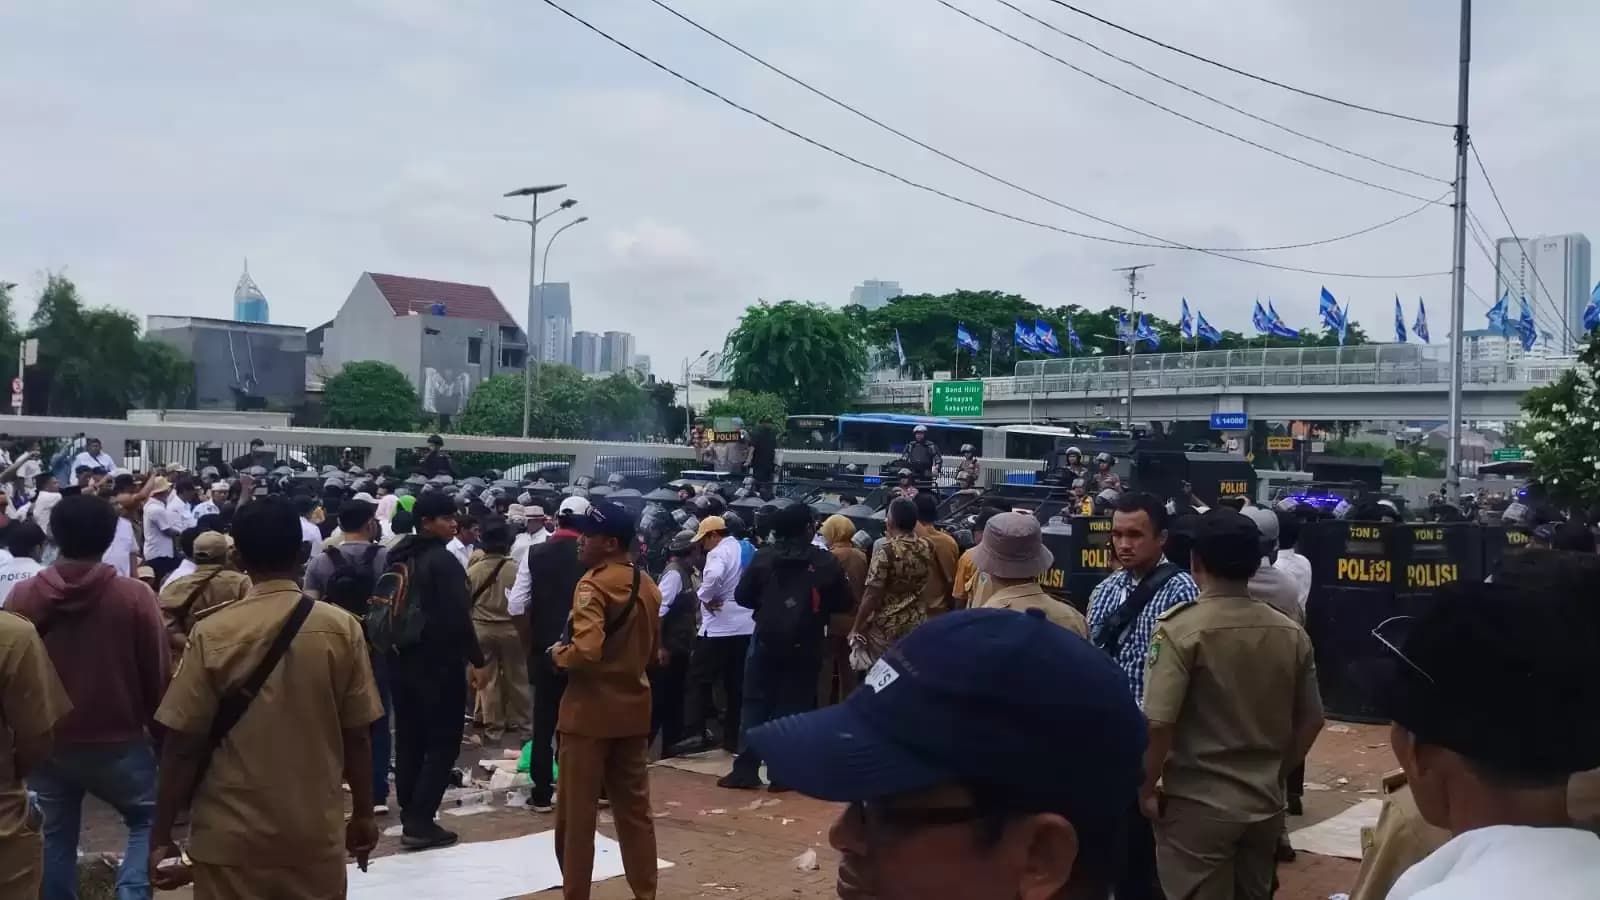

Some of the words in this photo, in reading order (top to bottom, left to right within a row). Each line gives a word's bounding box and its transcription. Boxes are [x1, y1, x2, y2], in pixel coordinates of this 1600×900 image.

[716, 431, 739, 441] POLISI
[1220, 482, 1247, 494] POLISI
[1414, 529, 1434, 540] YON
[1338, 558, 1391, 582] POLISI
[1407, 564, 1457, 587] POLISI
